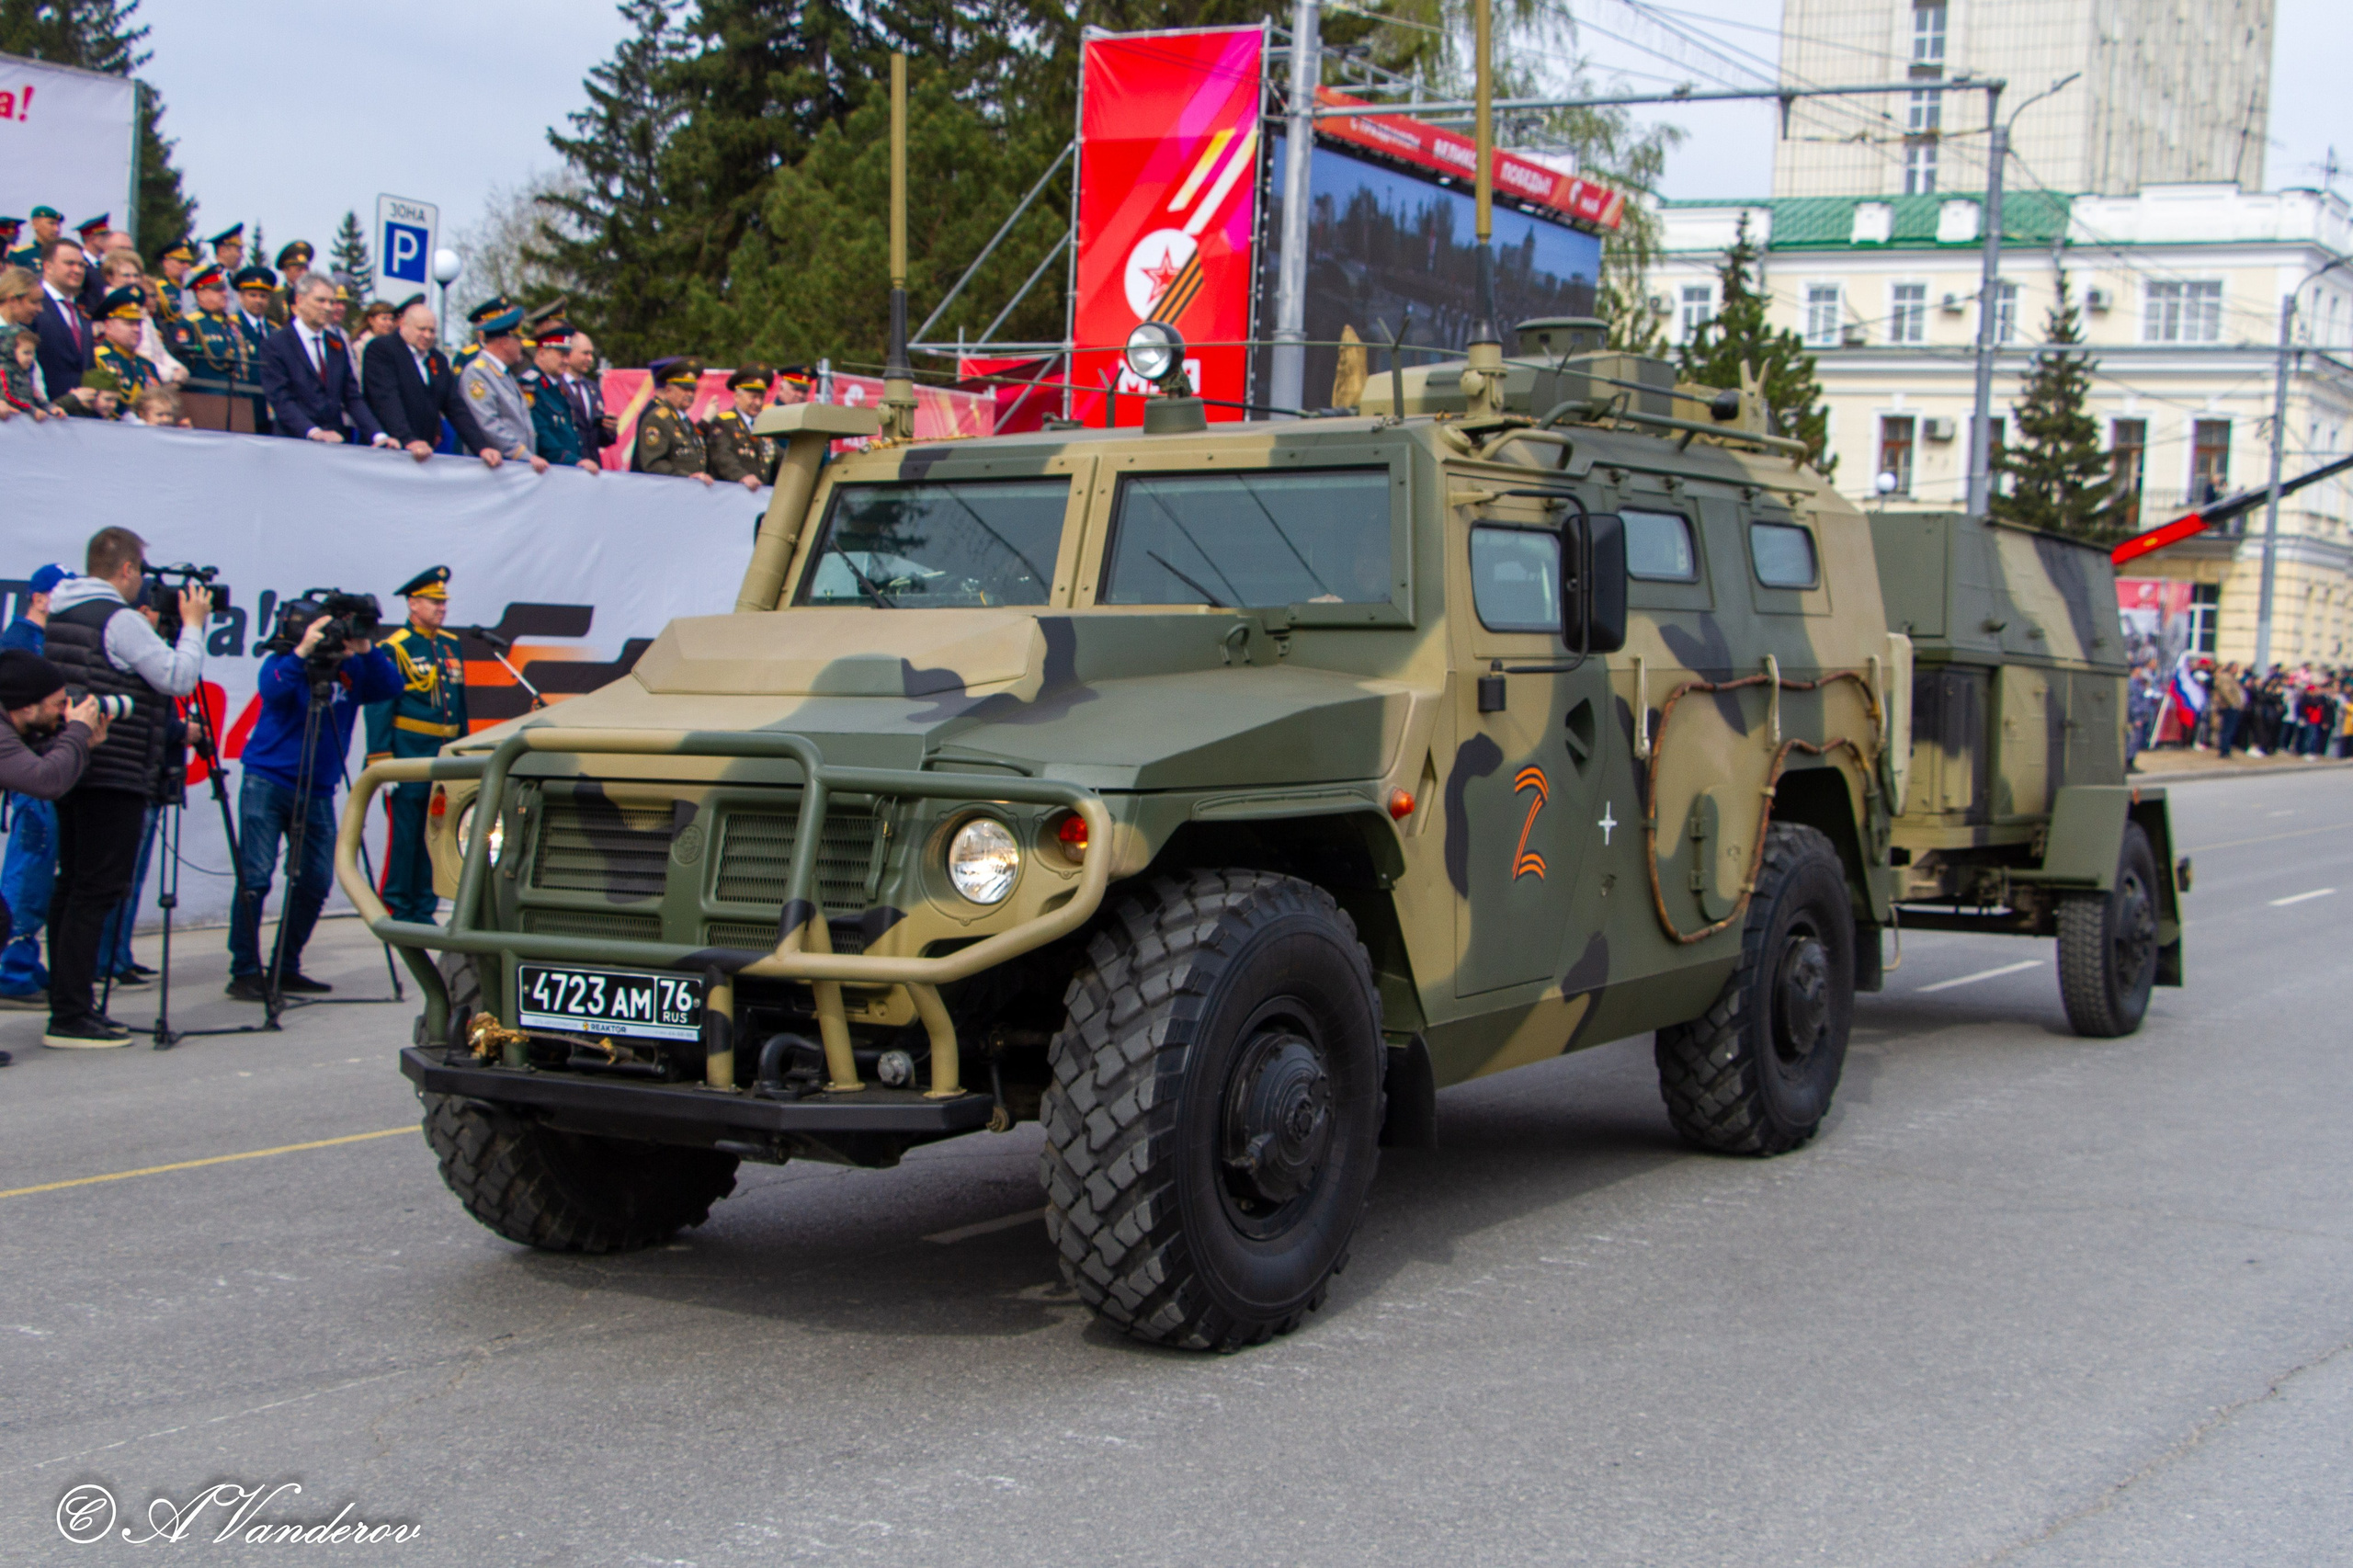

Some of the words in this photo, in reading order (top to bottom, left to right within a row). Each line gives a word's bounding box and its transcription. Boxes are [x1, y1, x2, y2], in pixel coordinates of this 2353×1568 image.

[390, 201, 426, 222] ЗОНА
[392, 228, 419, 274] P
[532, 971, 607, 1016] 4723
[610, 986, 653, 1020] АМ
[659, 979, 693, 1012] 76
[589, 1023, 628, 1034] REAKTOR
[662, 1011, 688, 1025] RUS
